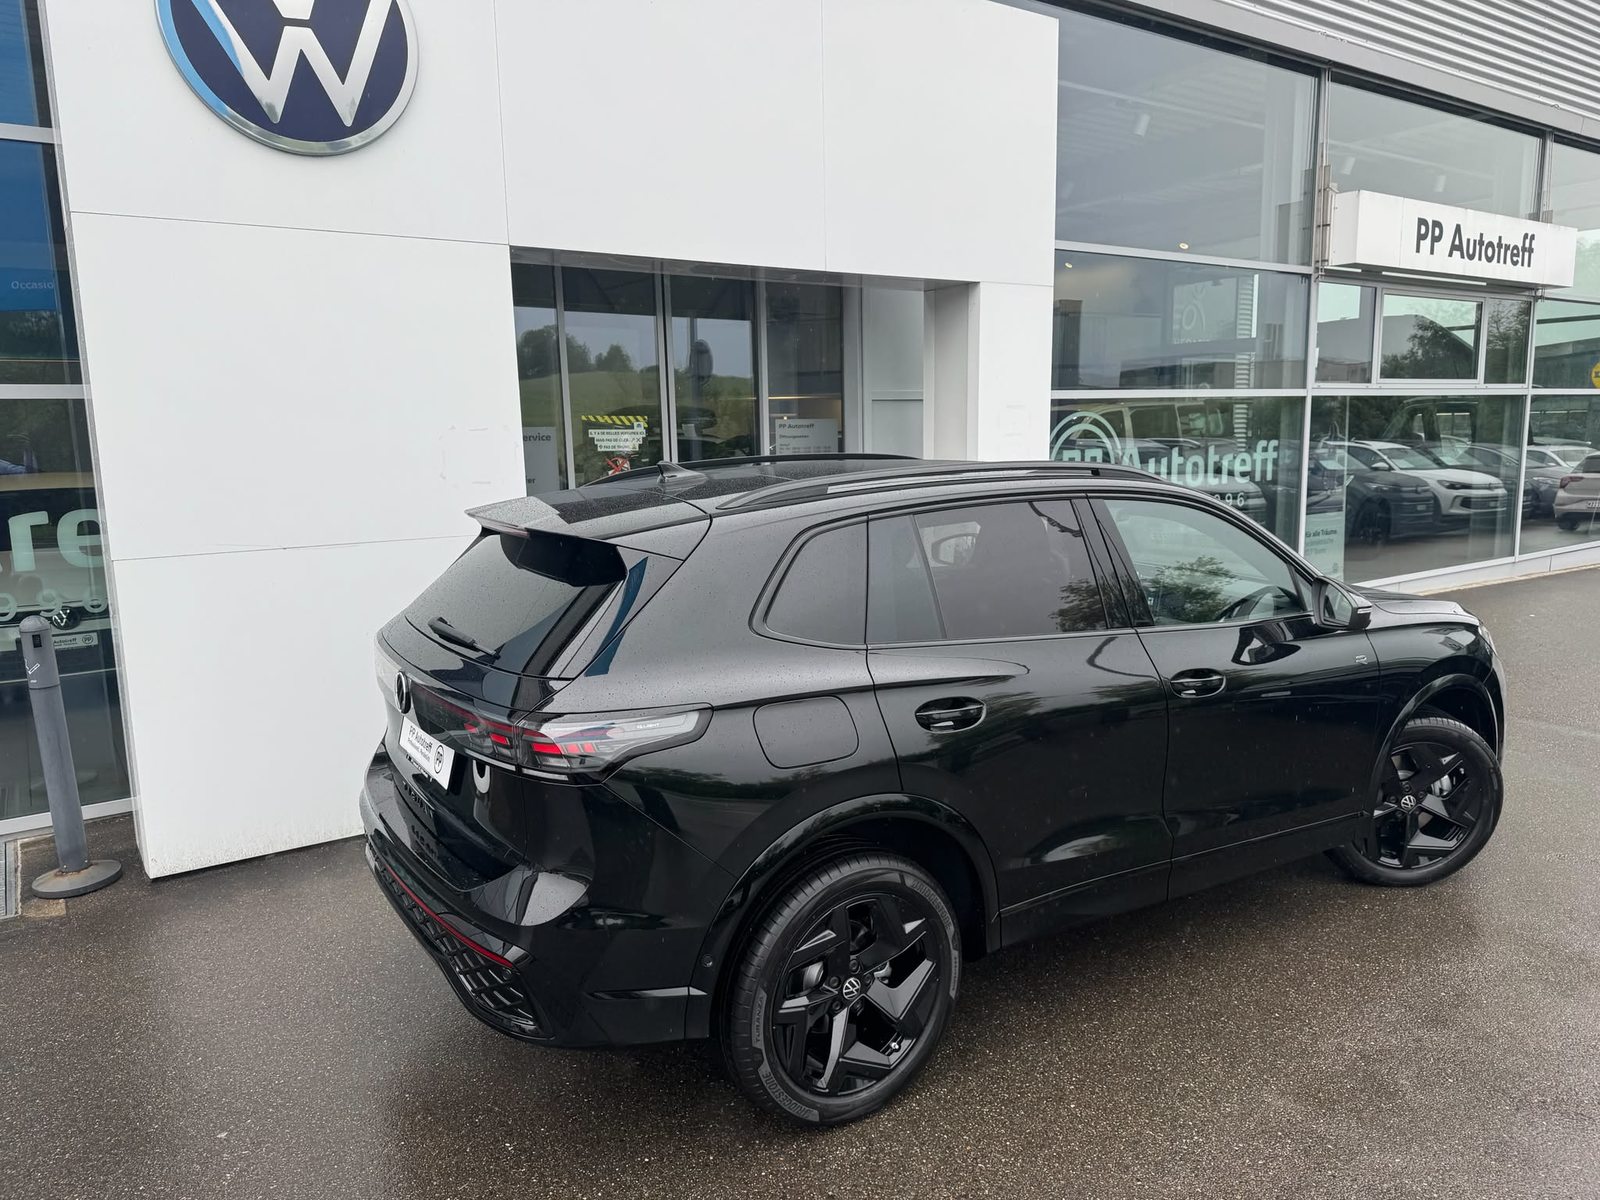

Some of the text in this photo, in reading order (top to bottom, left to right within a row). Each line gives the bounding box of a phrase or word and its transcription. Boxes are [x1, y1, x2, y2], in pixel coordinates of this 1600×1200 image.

[1415, 217, 1535, 268] PP Autotreff
[1121, 439, 1279, 487] Autotreff
[409, 725, 416, 738] PP
[415, 731, 433, 754] Autotreff
